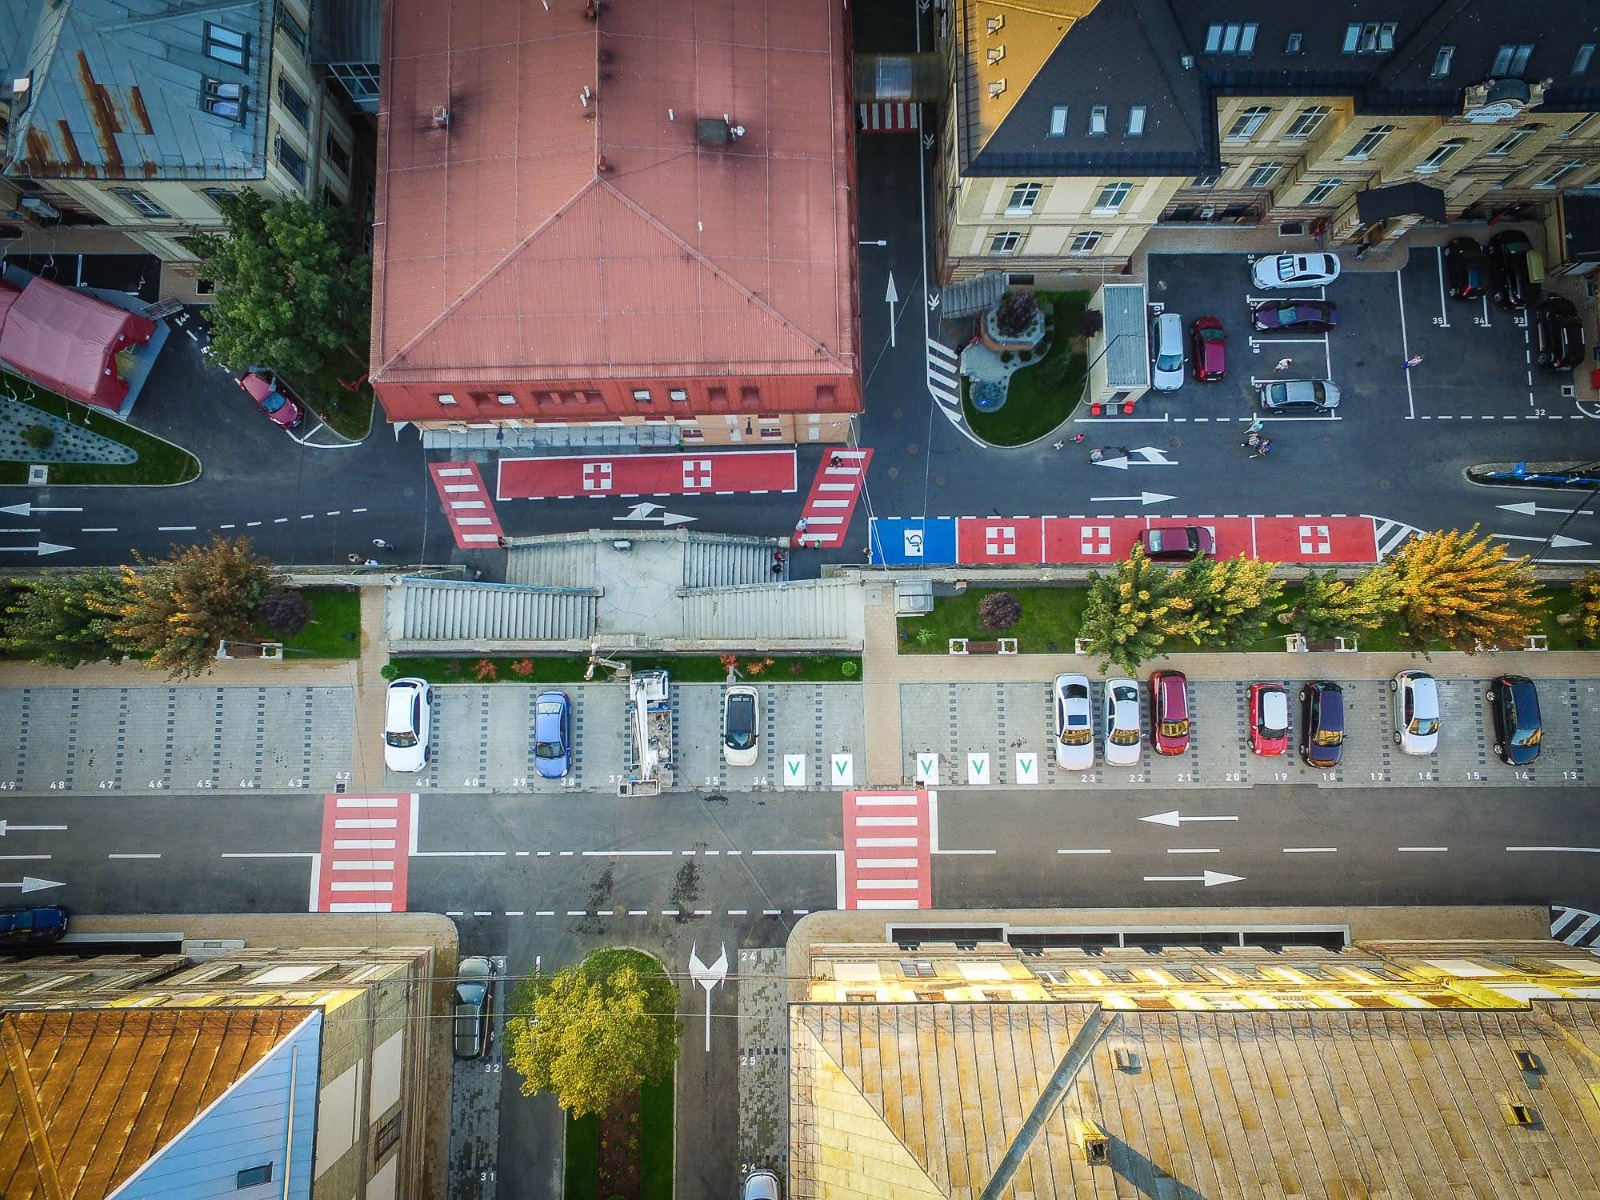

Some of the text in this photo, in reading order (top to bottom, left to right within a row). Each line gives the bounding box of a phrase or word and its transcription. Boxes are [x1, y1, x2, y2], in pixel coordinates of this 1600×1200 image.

[1248, 255, 1254, 264] 36
[180, 313, 190, 322] 44
[1253, 344, 1260, 353] 38
[788, 761, 800, 776] V
[836, 761, 847, 776] V
[921, 760, 933, 774] V
[972, 760, 984, 774] V
[1020, 759, 1032, 774] V
[336, 772, 349, 780] 42
[609, 775, 623, 784] 37
[1130, 774, 1143, 782] 22
[1178, 774, 1192, 782] 21
[1226, 773, 1240, 781] 20
[1275, 773, 1287, 781] 19
[1323, 773, 1336, 781] 18
[1419, 772, 1432, 780] 16
[1467, 772, 1480, 780] 15
[1564, 772, 1577, 780] 13
[99, 781, 113, 789] 47
[149, 781, 163, 789] 46
[197, 780, 211, 788] 45
[240, 780, 253, 788] 44
[464, 778, 478, 786] 40
[513, 778, 526, 786] 39
[561, 778, 574, 786] 38
[705, 777, 718, 785] 35
[753, 777, 767, 785] 34
[1, 782, 14, 790] 49
[50, 782, 65, 790] 48
[742, 952, 756, 961] 24
[742, 1057, 756, 1065] 25
[485, 1064, 499, 1072] 32
[742, 1164, 755, 1173] 26
[480, 1172, 494, 1181] 31
